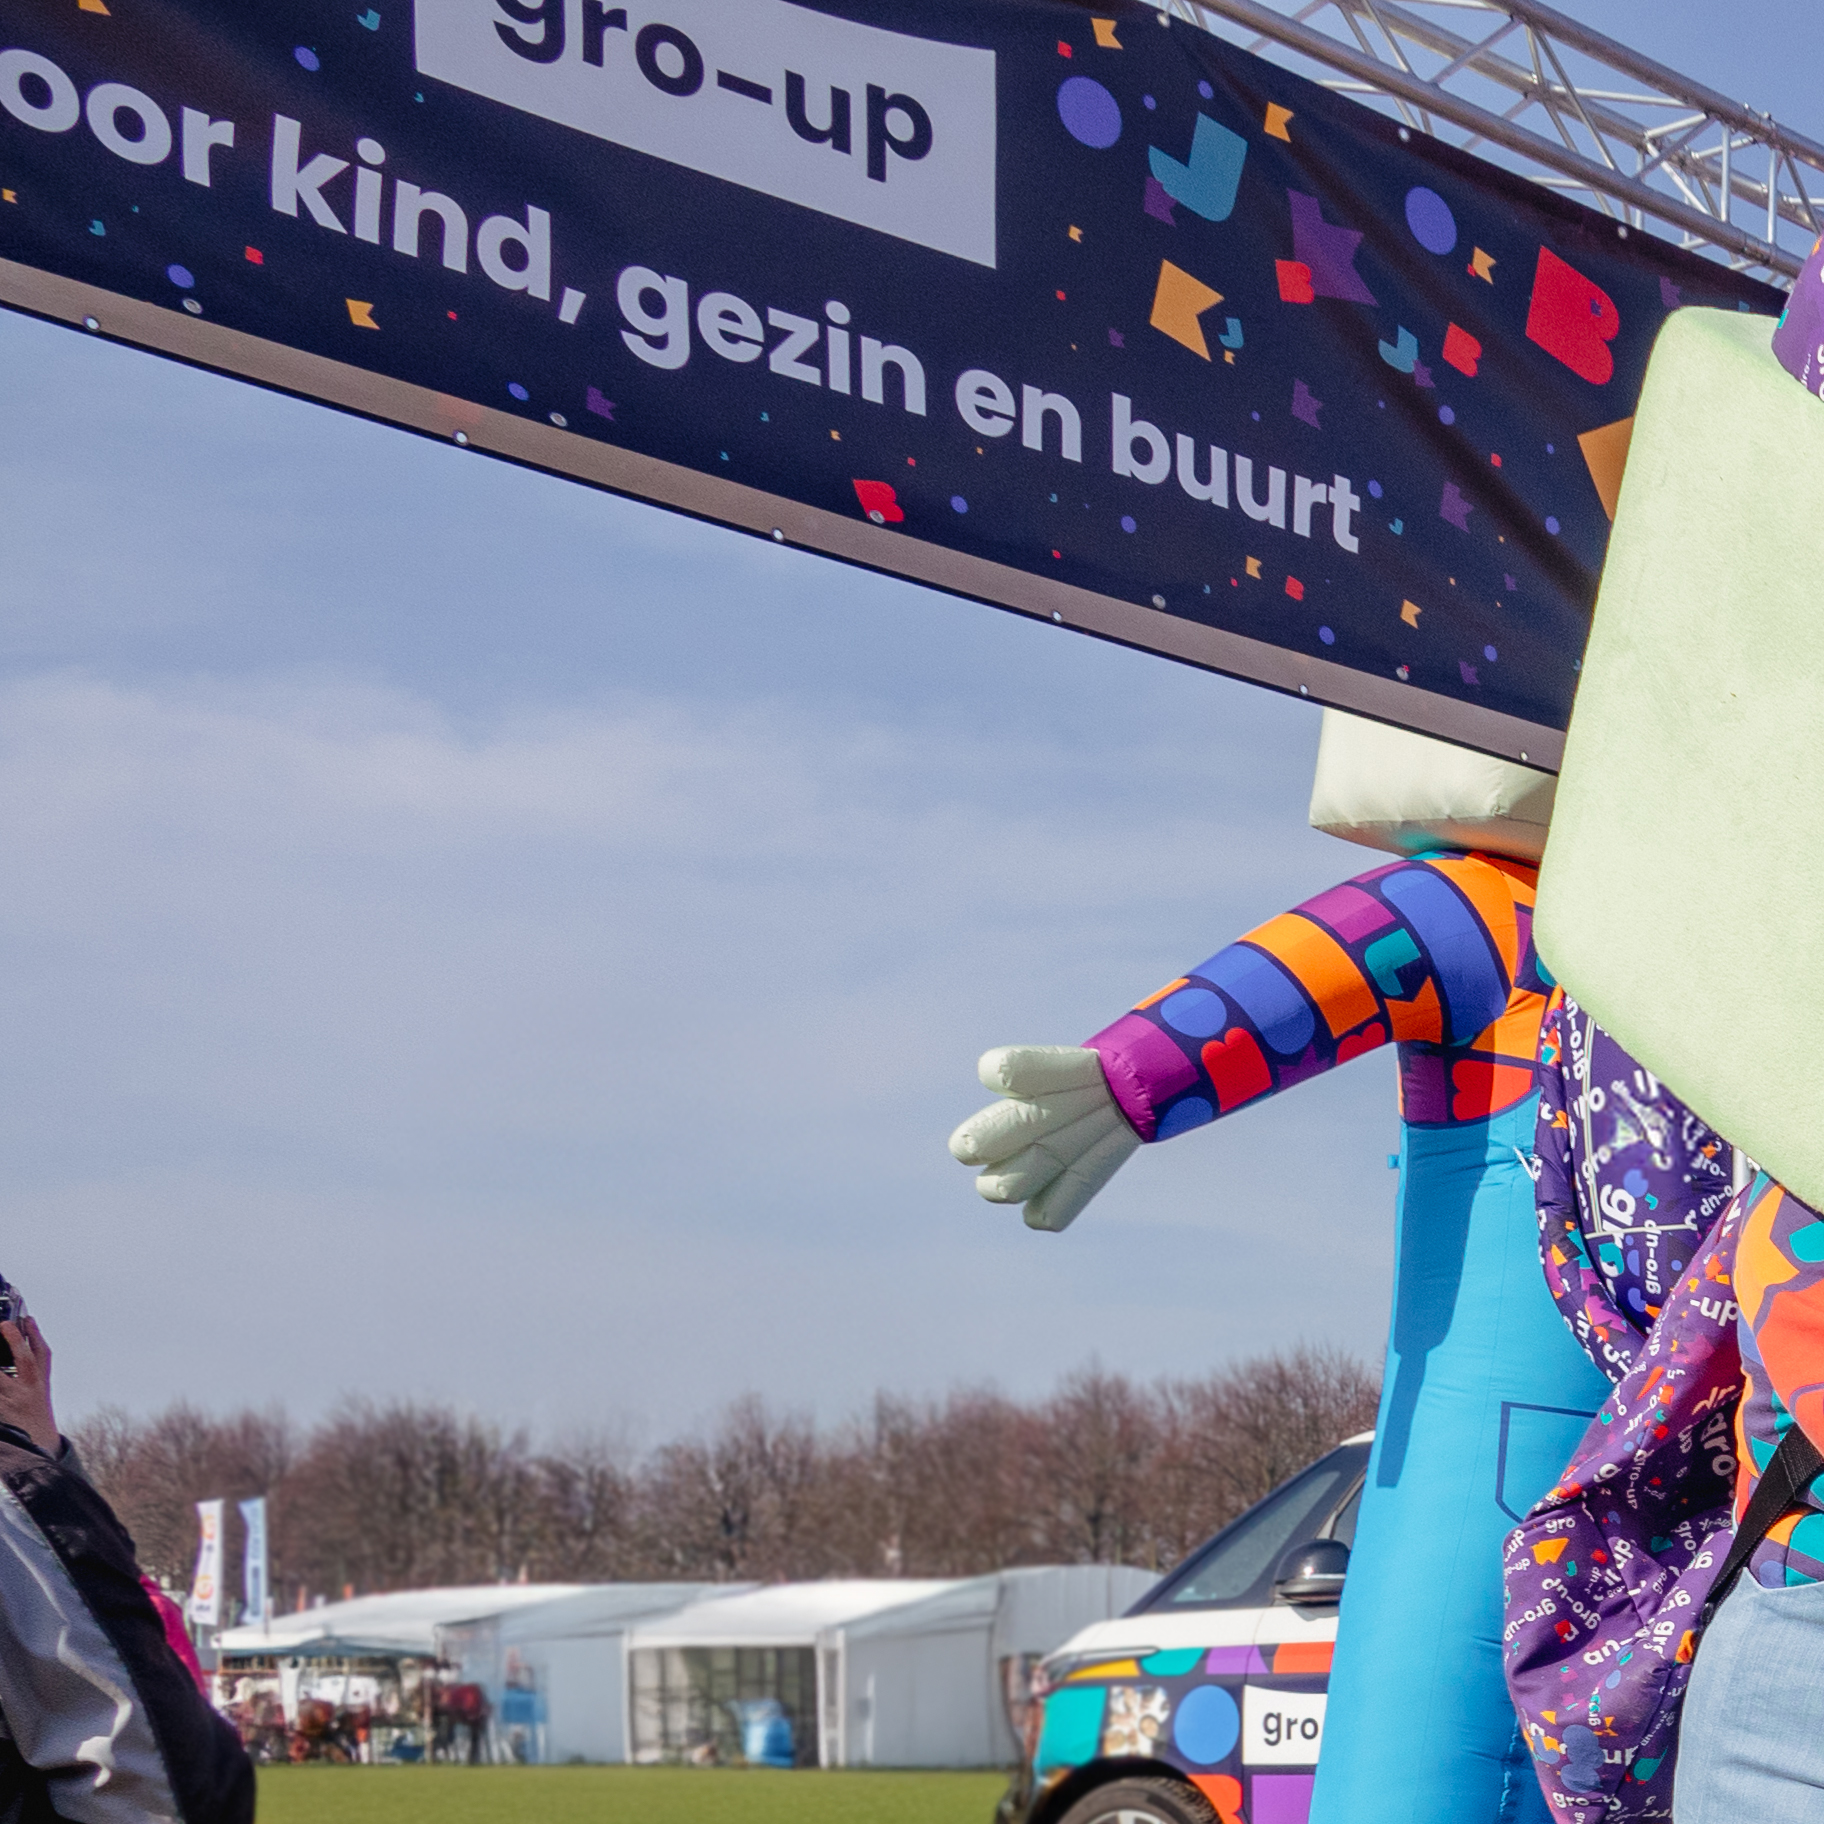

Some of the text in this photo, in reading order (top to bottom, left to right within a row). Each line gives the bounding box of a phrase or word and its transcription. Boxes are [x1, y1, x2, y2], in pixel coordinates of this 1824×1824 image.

[494, 0, 933, 182] gro-up
[0, 49, 1361, 554] oor kind, gezin en buurt
[1541, 1576, 1602, 1630] gro-up
